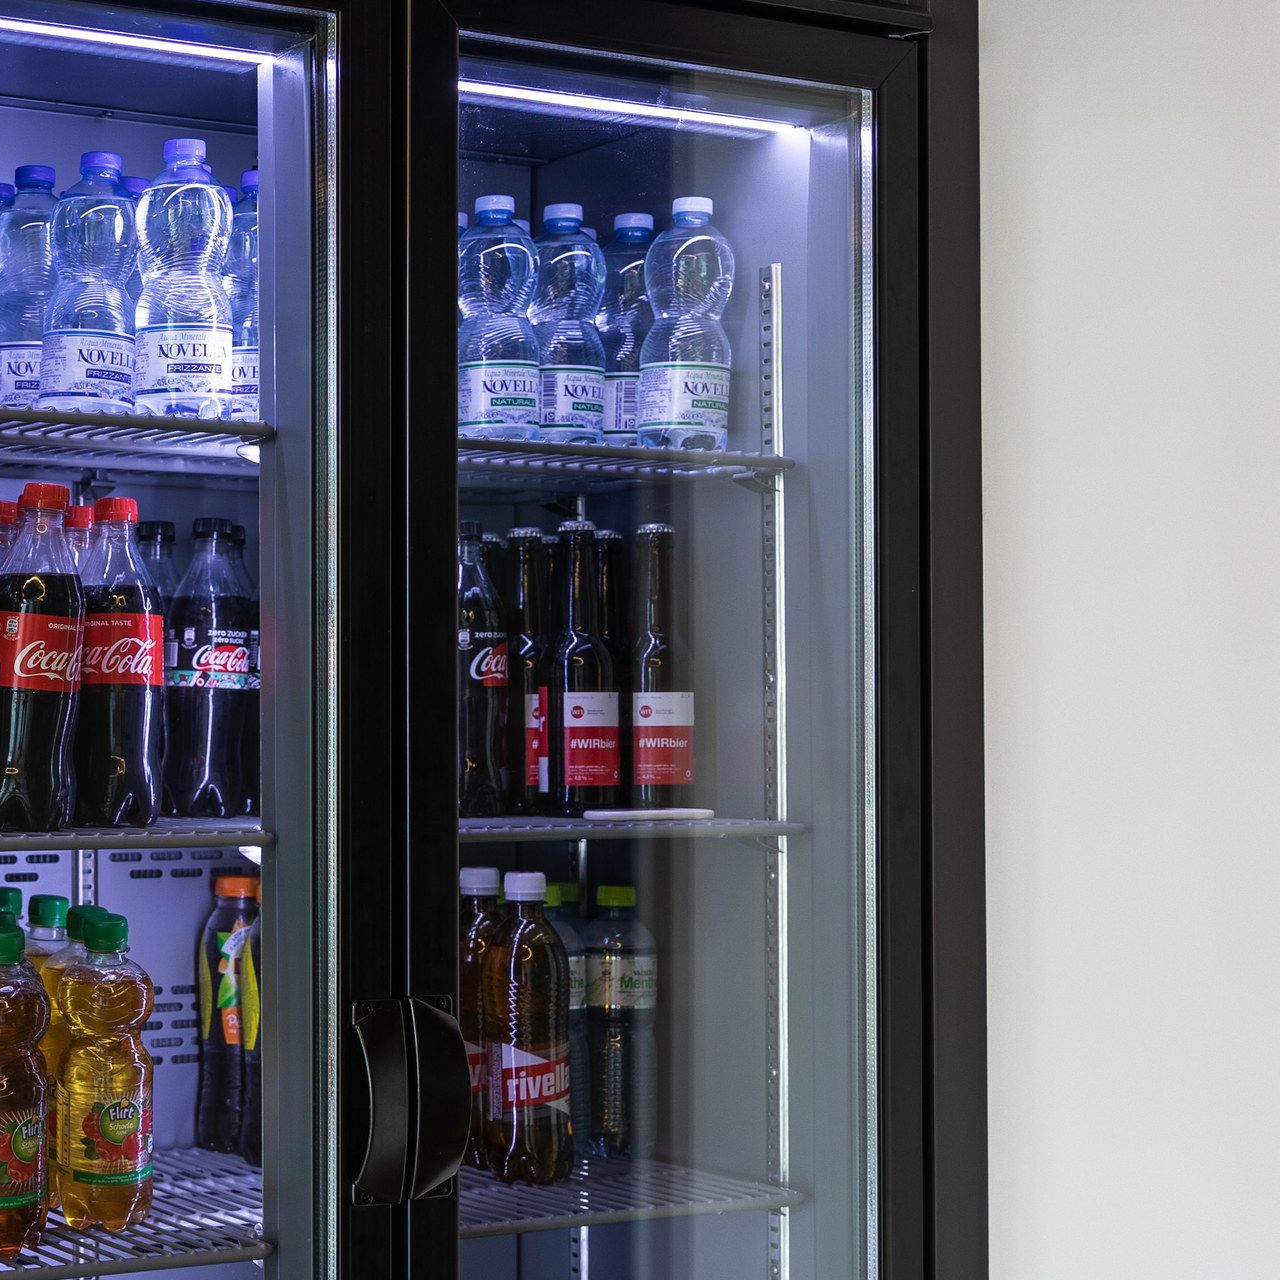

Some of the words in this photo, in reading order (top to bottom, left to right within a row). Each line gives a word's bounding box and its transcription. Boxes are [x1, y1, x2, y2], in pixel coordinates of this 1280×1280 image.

[168, 364, 221, 373] FRIZZANTE
[87, 369, 131, 384] FRIZZANTE
[491, 398, 536, 407] NATURALE
[570, 738, 616, 749] #WIRbier
[639, 737, 688, 748] #WIRbier
[109, 1106, 134, 1121] Flirt
